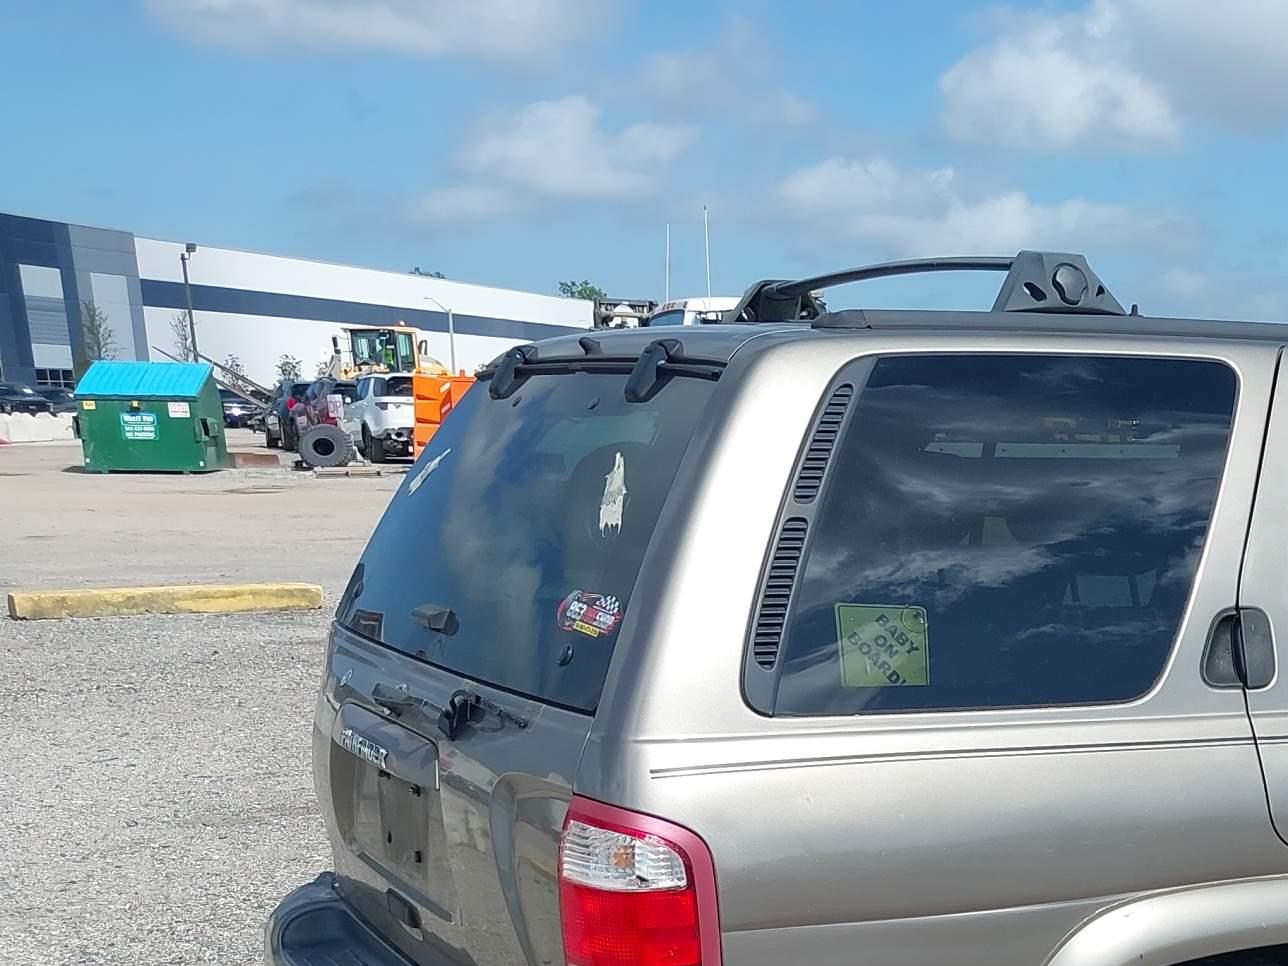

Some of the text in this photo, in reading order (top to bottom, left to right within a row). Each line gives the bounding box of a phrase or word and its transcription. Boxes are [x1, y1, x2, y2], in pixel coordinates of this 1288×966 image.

[873, 634, 899, 659] ON
[875, 613, 920, 654] BABY
[340, 728, 388, 769] PATHFINDER
